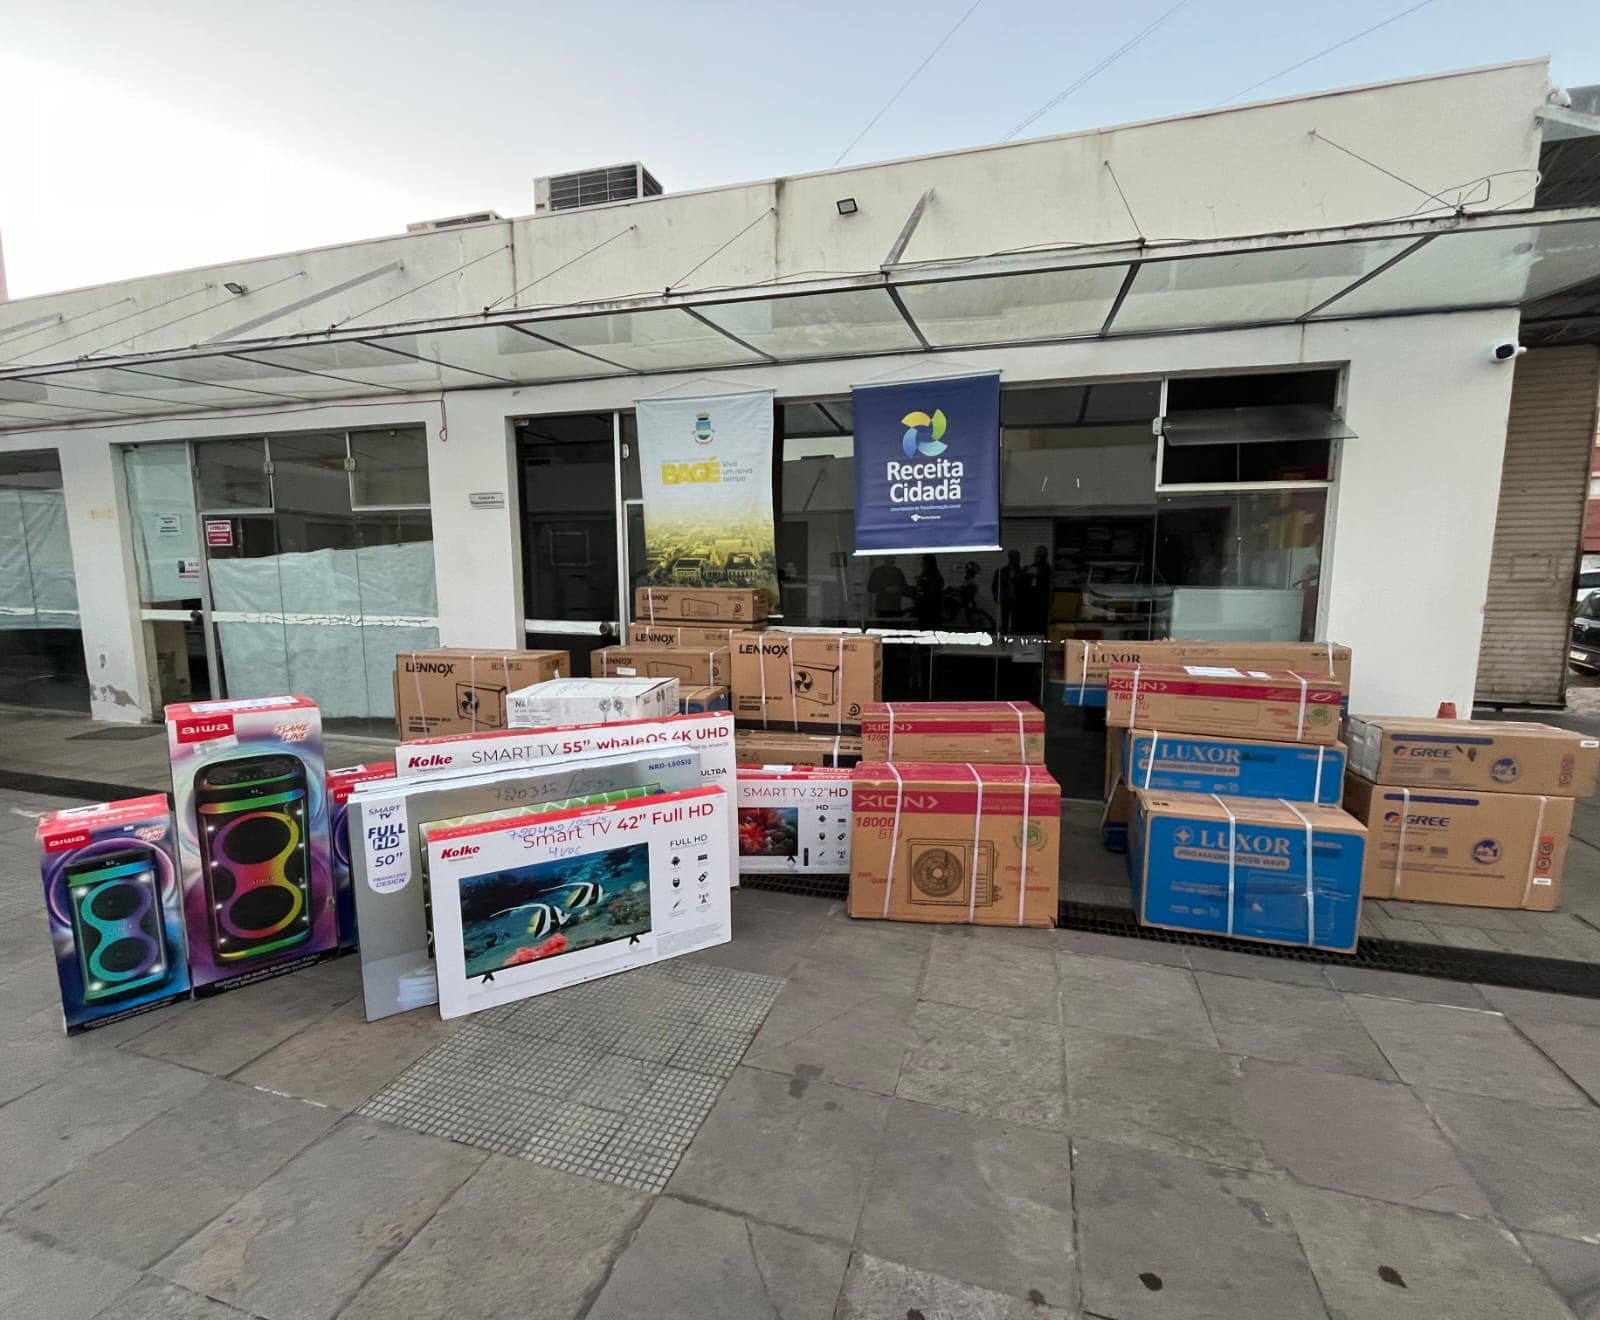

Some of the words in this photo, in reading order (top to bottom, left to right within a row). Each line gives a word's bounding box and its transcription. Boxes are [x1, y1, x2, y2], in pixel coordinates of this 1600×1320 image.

[661, 456, 720, 485] BAGÉ
[887, 458, 964, 481] Receita
[890, 479, 962, 503] Cidadã
[635, 633, 674, 646] LENNOX
[739, 643, 789, 659] LENNOX
[1092, 653, 1141, 664] LUXOR
[405, 662, 455, 678] LENNOX
[1115, 692, 1144, 701] 1800
[181, 722, 230, 735] aiwa
[472, 745, 532, 764] SMART
[538, 743, 558, 757] TV
[672, 730, 692, 742] 4K
[696, 726, 729, 740] UHD
[1161, 743, 1240, 764] LUXOR
[1410, 747, 1456, 759] GREE
[408, 755, 453, 769] Kolke
[701, 767, 727, 777] ULTRA
[743, 787, 787, 798] SMART
[792, 787, 807, 797] TV
[369, 804, 400, 816] SMART
[379, 812, 392, 820] TV
[523, 825, 582, 849] Smart
[588, 820, 611, 838] TV
[652, 807, 683, 825] Full
[688, 803, 714, 818] HD
[856, 817, 896, 828] 18000
[1404, 814, 1451, 827] GREE
[368, 822, 406, 839] FULL
[48, 835, 86, 847] aiwa
[373, 835, 400, 851] HD
[670, 837, 692, 847] FULL
[694, 834, 708, 842] HD
[1201, 830, 1291, 856] LUXOR
[441, 845, 480, 859] Kolke
